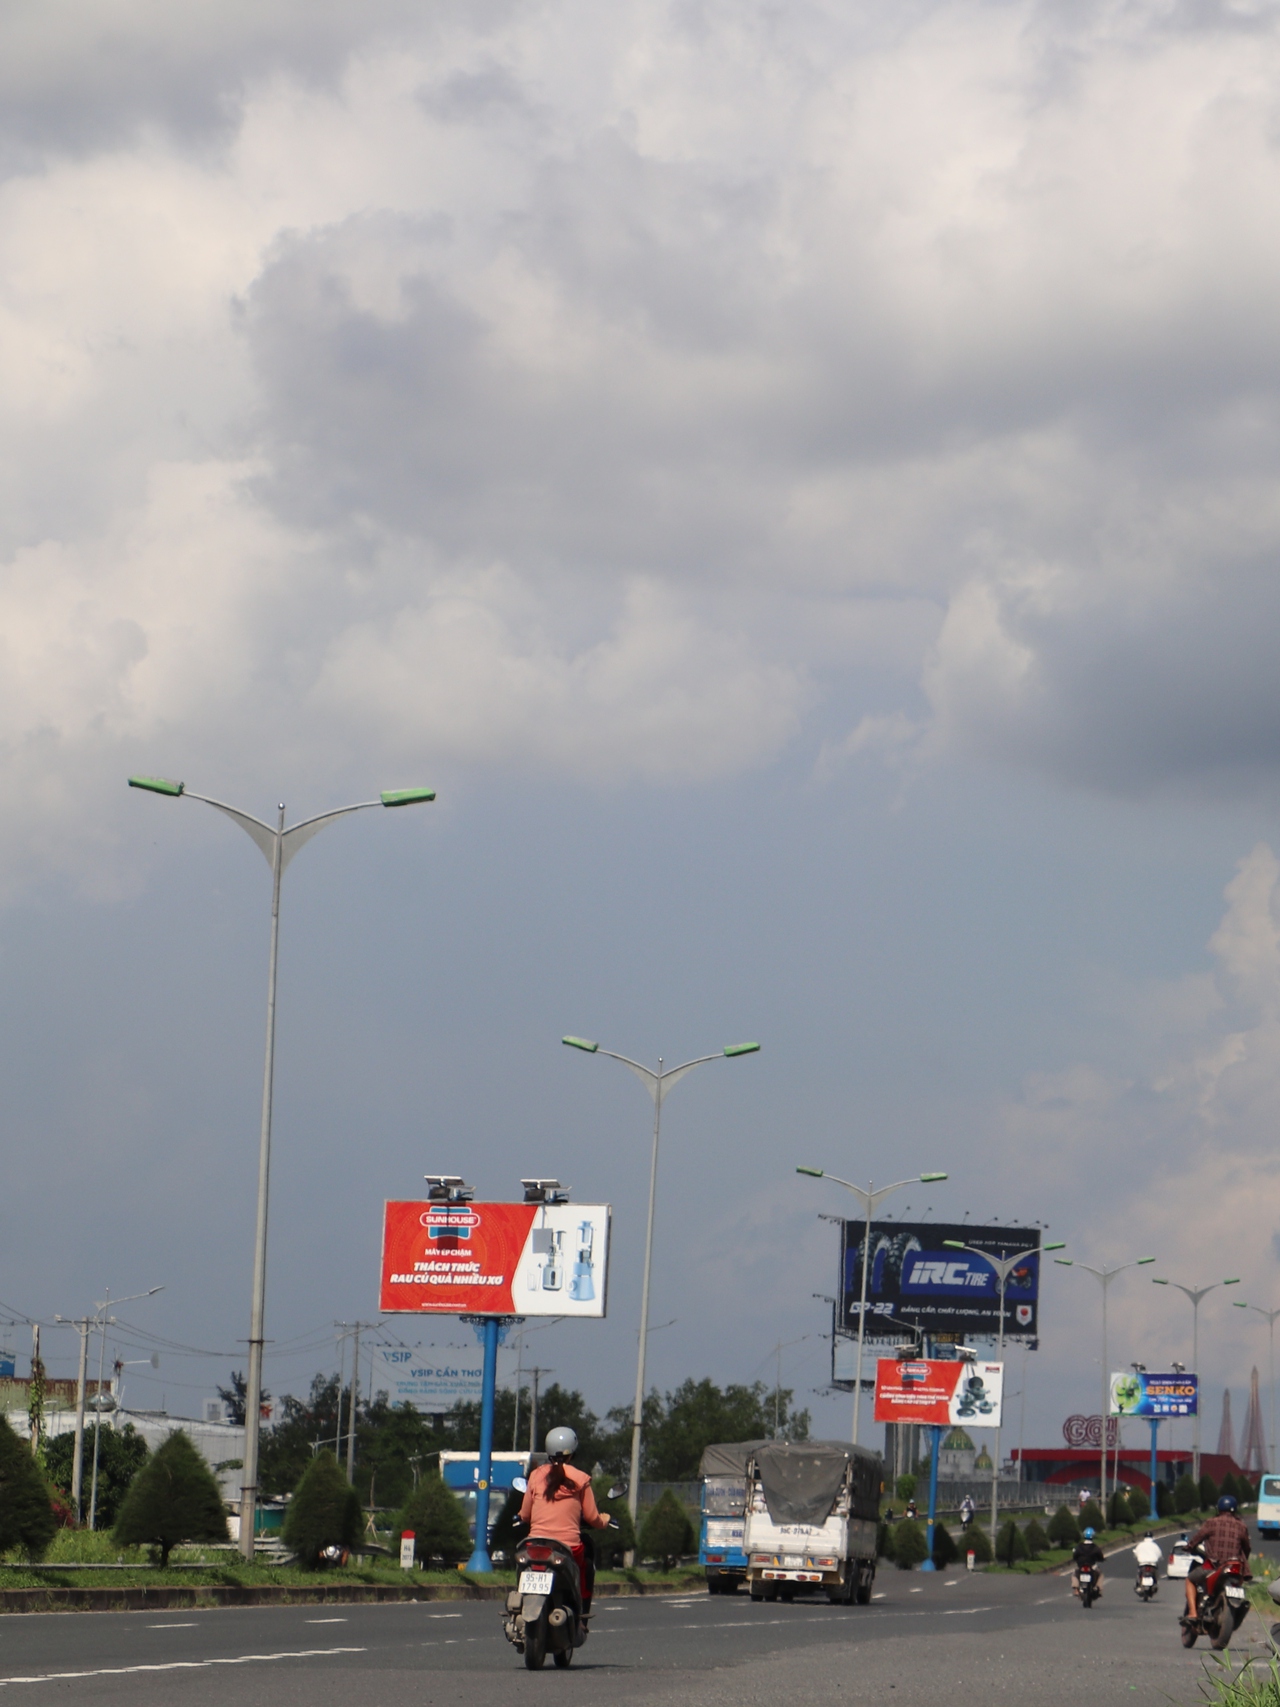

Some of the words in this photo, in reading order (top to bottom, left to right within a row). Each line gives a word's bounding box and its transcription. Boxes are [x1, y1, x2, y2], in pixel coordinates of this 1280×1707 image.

[425, 1216, 475, 1224] SUNHOUSE
[413, 1261, 450, 1272] THÁCH
[451, 1261, 481, 1273] THỨC
[390, 1274, 414, 1284] RAU
[429, 1272, 452, 1285] QUẢ
[452, 1273, 487, 1285] NHIỀU
[486, 1275, 504, 1285] XƠ
[964, 1272, 990, 1286] TIRE
[383, 1351, 412, 1363] VSIP
[411, 1369, 433, 1378] VSIP
[461, 1369, 483, 1377] THƠ
[1146, 1385, 1195, 1396] SENKO
